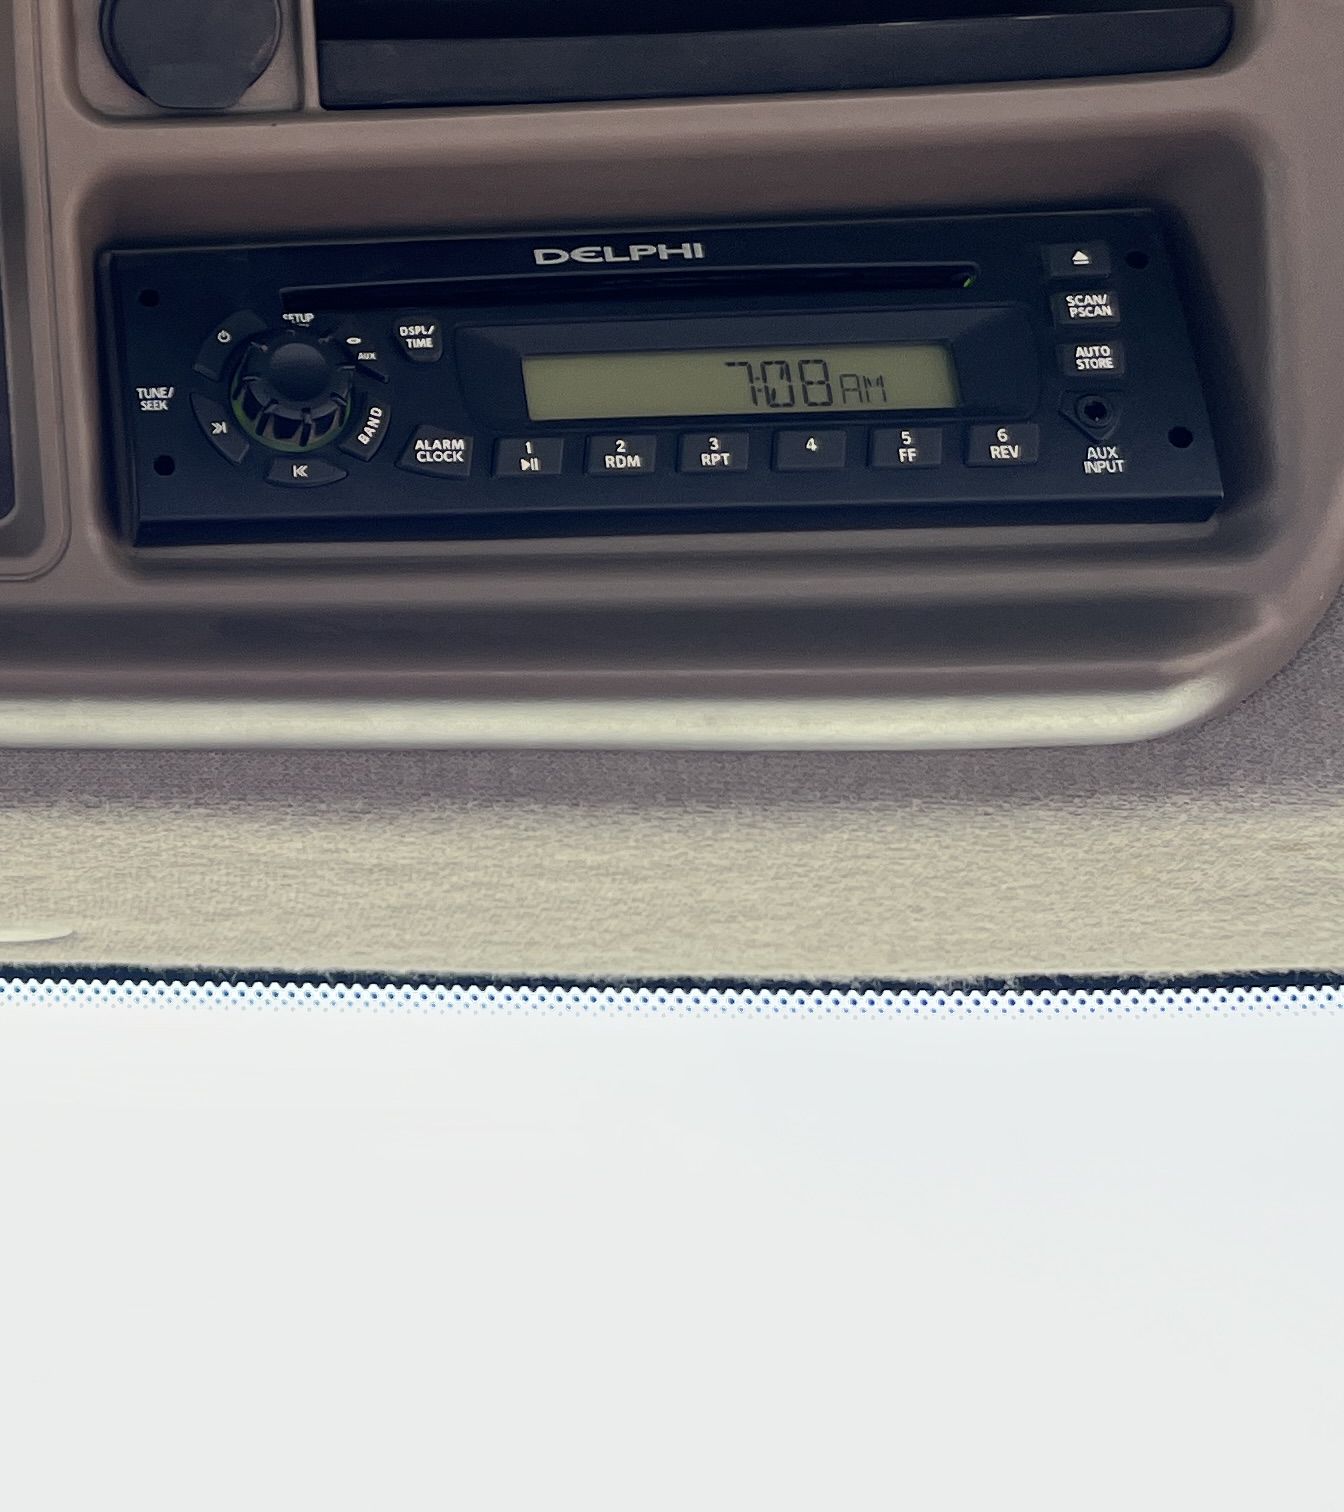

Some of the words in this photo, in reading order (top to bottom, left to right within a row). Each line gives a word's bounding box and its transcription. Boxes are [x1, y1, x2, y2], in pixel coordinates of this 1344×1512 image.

[533, 242, 704, 265] DELPHI
[1065, 293, 1108, 307] SCAN/
[1068, 303, 1114, 318] PSCAN
[399, 325, 435, 337] DSPL/
[405, 337, 434, 349] TIME
[357, 352, 377, 360] AUX
[1075, 345, 1111, 358] AUTO
[1076, 357, 1114, 370] STORE
[135, 386, 174, 399] TUNE/
[839, 373, 887, 405] AM
[140, 399, 169, 411] SEEK
[357, 406, 383, 445] BAND
[901, 431, 912, 445] 5
[996, 428, 1008, 443] 6
[414, 439, 465, 451] ALARM
[525, 441, 532, 454] 1
[615, 439, 626, 453] 2
[708, 437, 719, 451] 3
[806, 437, 818, 451] 4
[416, 450, 464, 463] CLOCK
[898, 447, 917, 463] FF
[989, 444, 1019, 459] REV
[1087, 446, 1119, 459] AUX
[605, 454, 641, 469] RDM
[701, 452, 730, 467] RPT
[1083, 459, 1126, 474] INPUT
